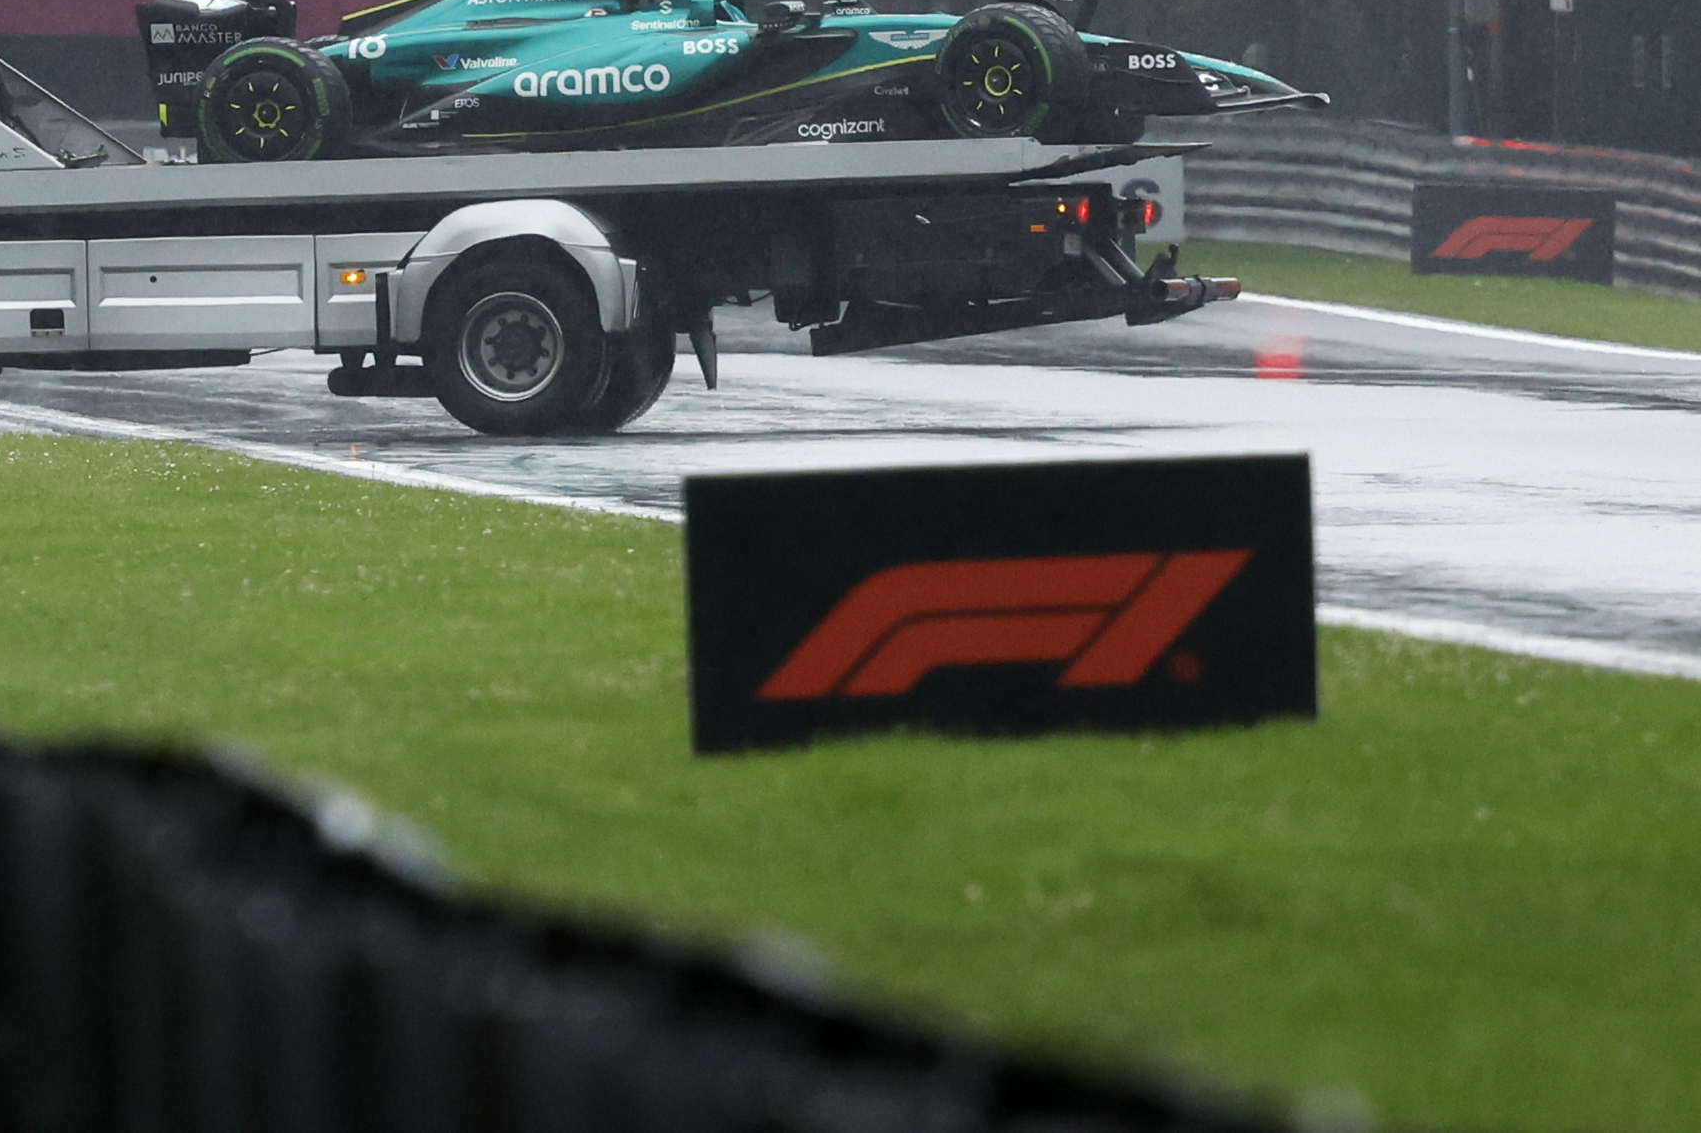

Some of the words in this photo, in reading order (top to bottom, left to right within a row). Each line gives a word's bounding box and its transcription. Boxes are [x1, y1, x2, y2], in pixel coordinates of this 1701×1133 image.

[176, 23, 218, 32] BANCO
[178, 32, 242, 44] MASTER
[683, 39, 739, 54] BOSS
[460, 56, 518, 69] Valvoline
[1128, 53, 1176, 69] BOSS
[157, 71, 203, 86] JUNIPE
[514, 64, 670, 97] aramco
[454, 98, 480, 108] EPOS
[798, 118, 885, 140] cognizant
[755, 549, 1253, 699] F1
